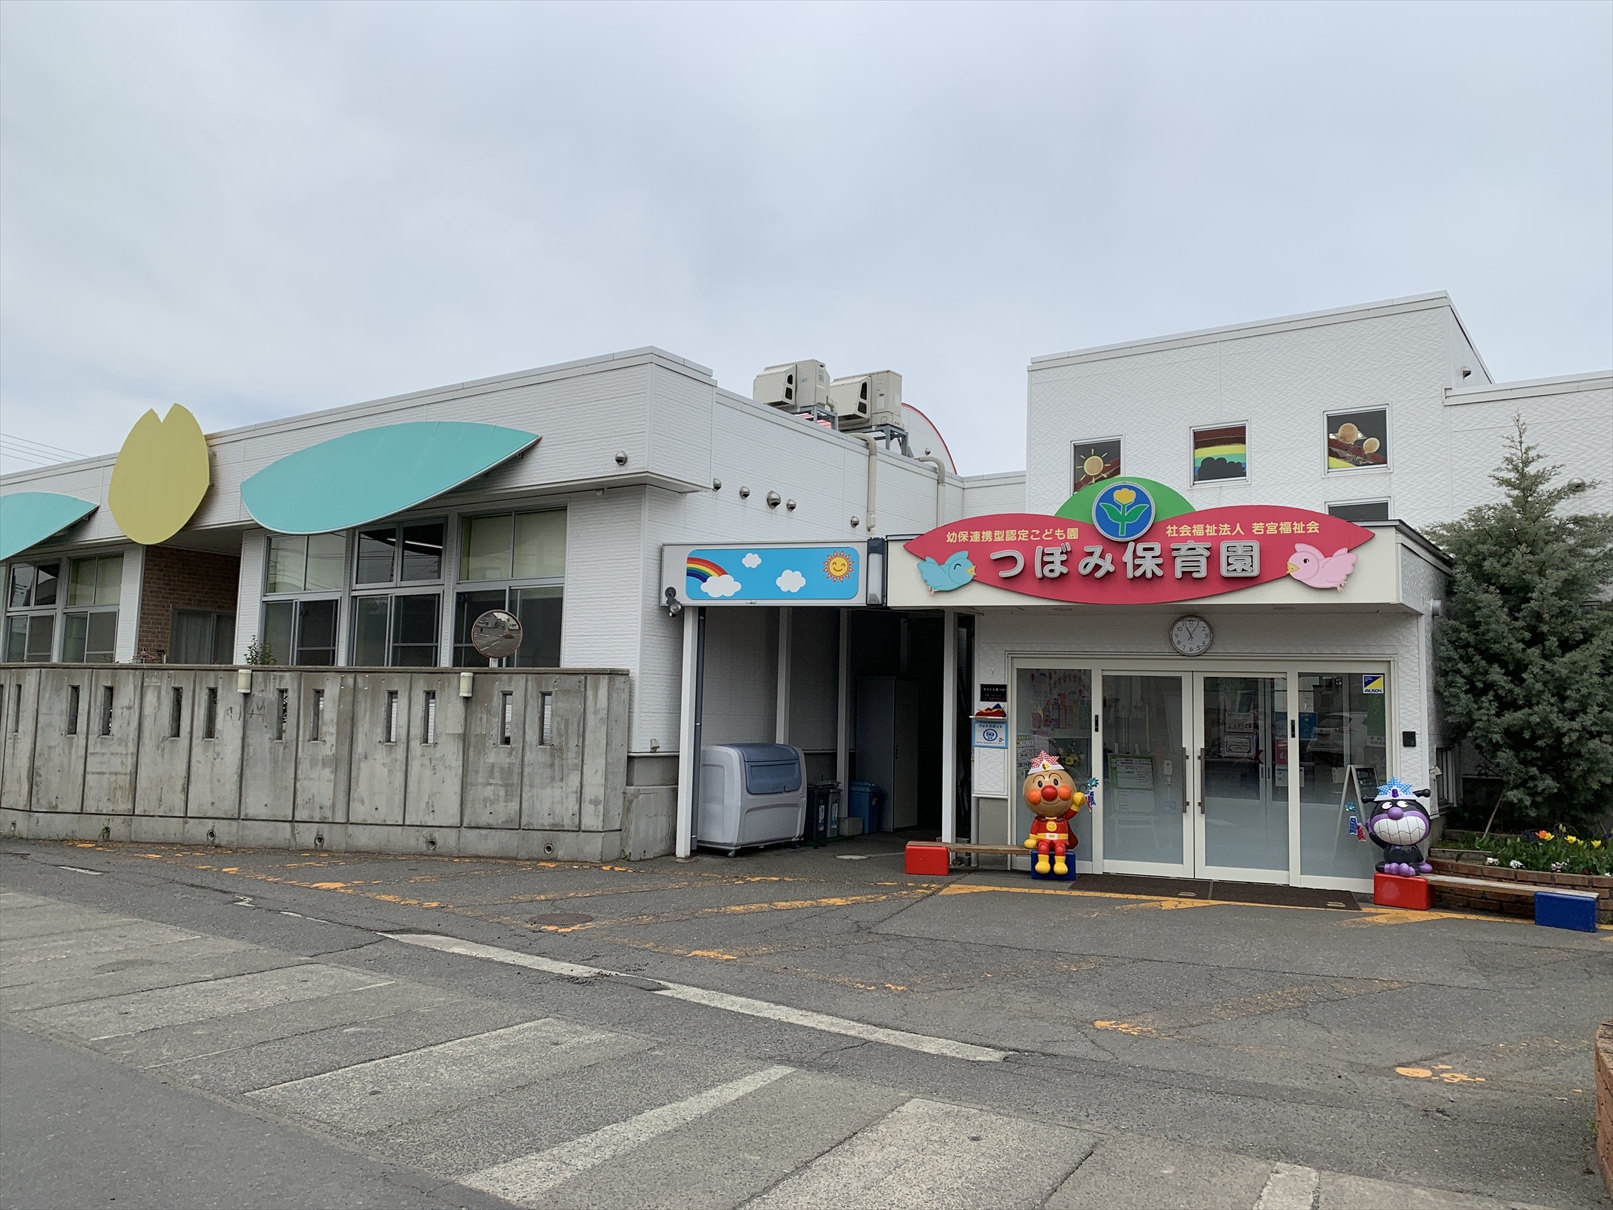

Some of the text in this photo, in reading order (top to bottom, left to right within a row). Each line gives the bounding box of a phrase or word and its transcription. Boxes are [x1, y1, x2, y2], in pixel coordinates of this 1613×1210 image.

[946, 527, 1079, 543] 幼保連携型認定こども園
[1165, 521, 1320, 537] 社会福祉法人 若宮福祉会
[990, 540, 1261, 579] つぼみ保育園
